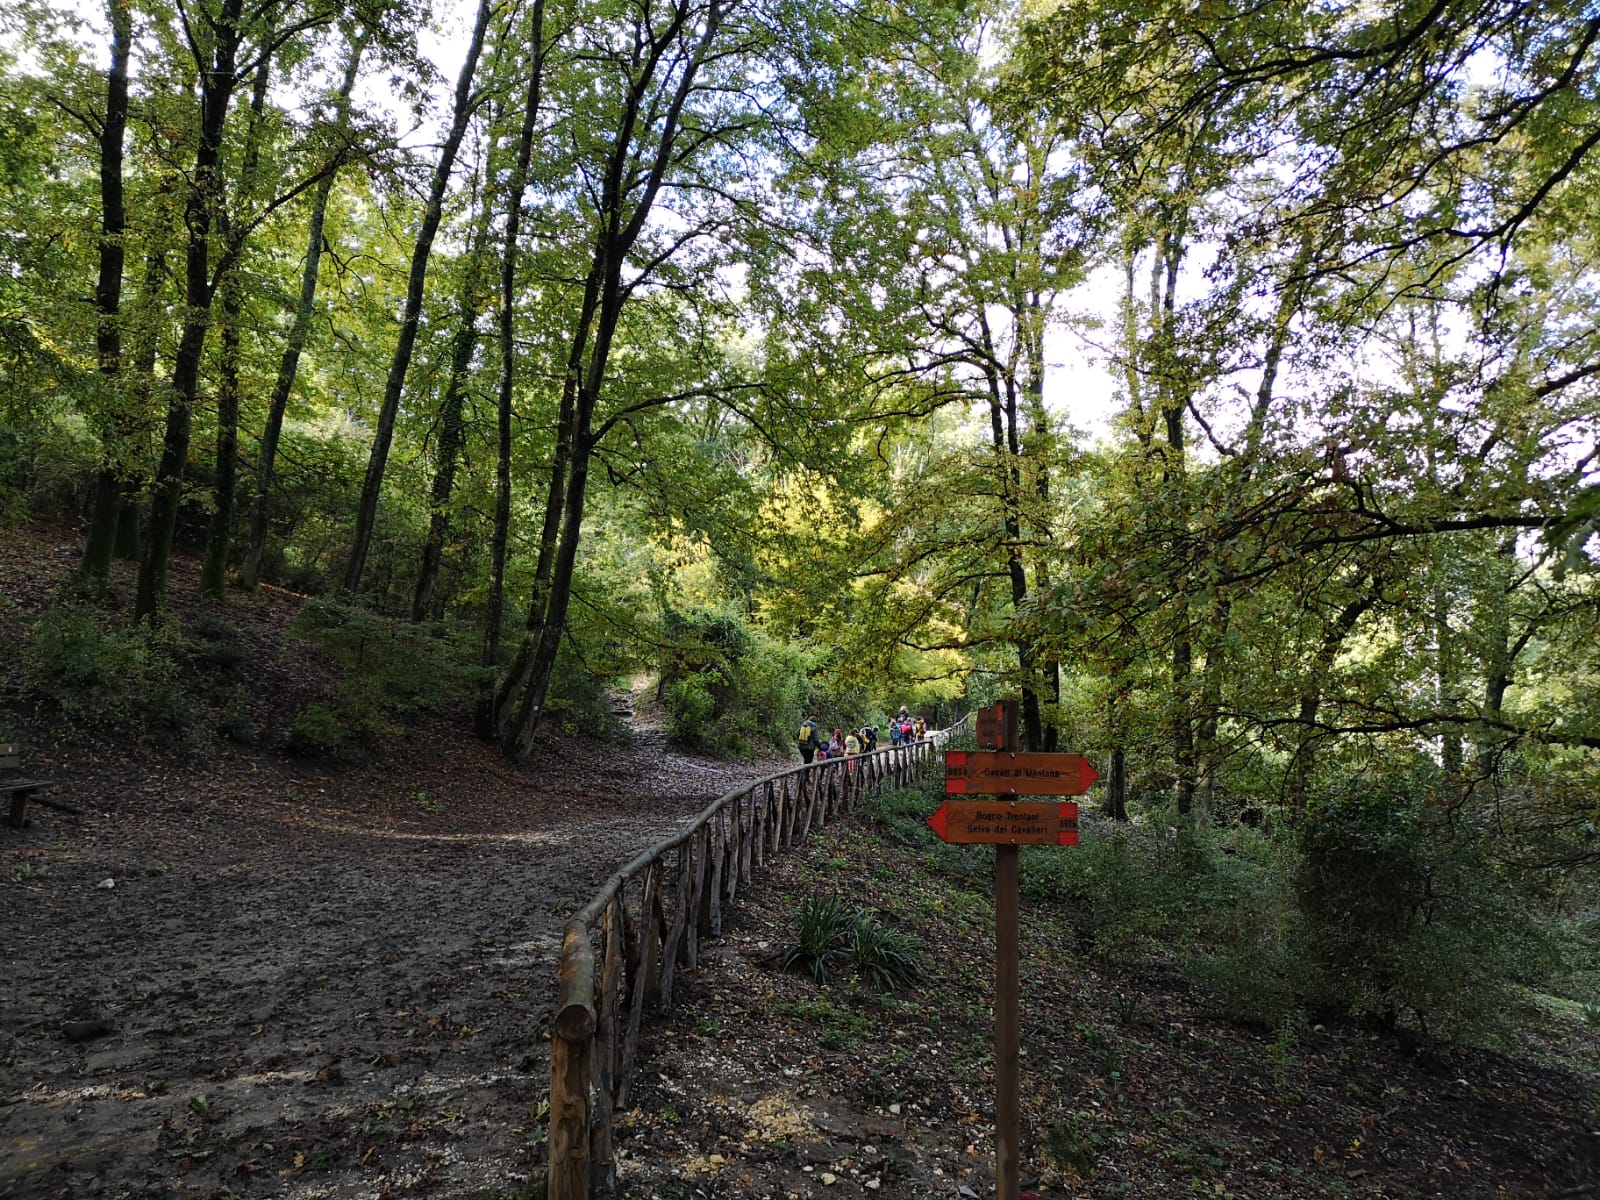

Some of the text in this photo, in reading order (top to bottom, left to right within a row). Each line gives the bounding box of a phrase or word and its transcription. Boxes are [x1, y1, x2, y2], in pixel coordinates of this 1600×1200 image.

[1014, 767, 1022, 777] di
[976, 811, 1039, 821] Bosco Trentani
[967, 824, 1048, 834] Selva dei Cavalieri
